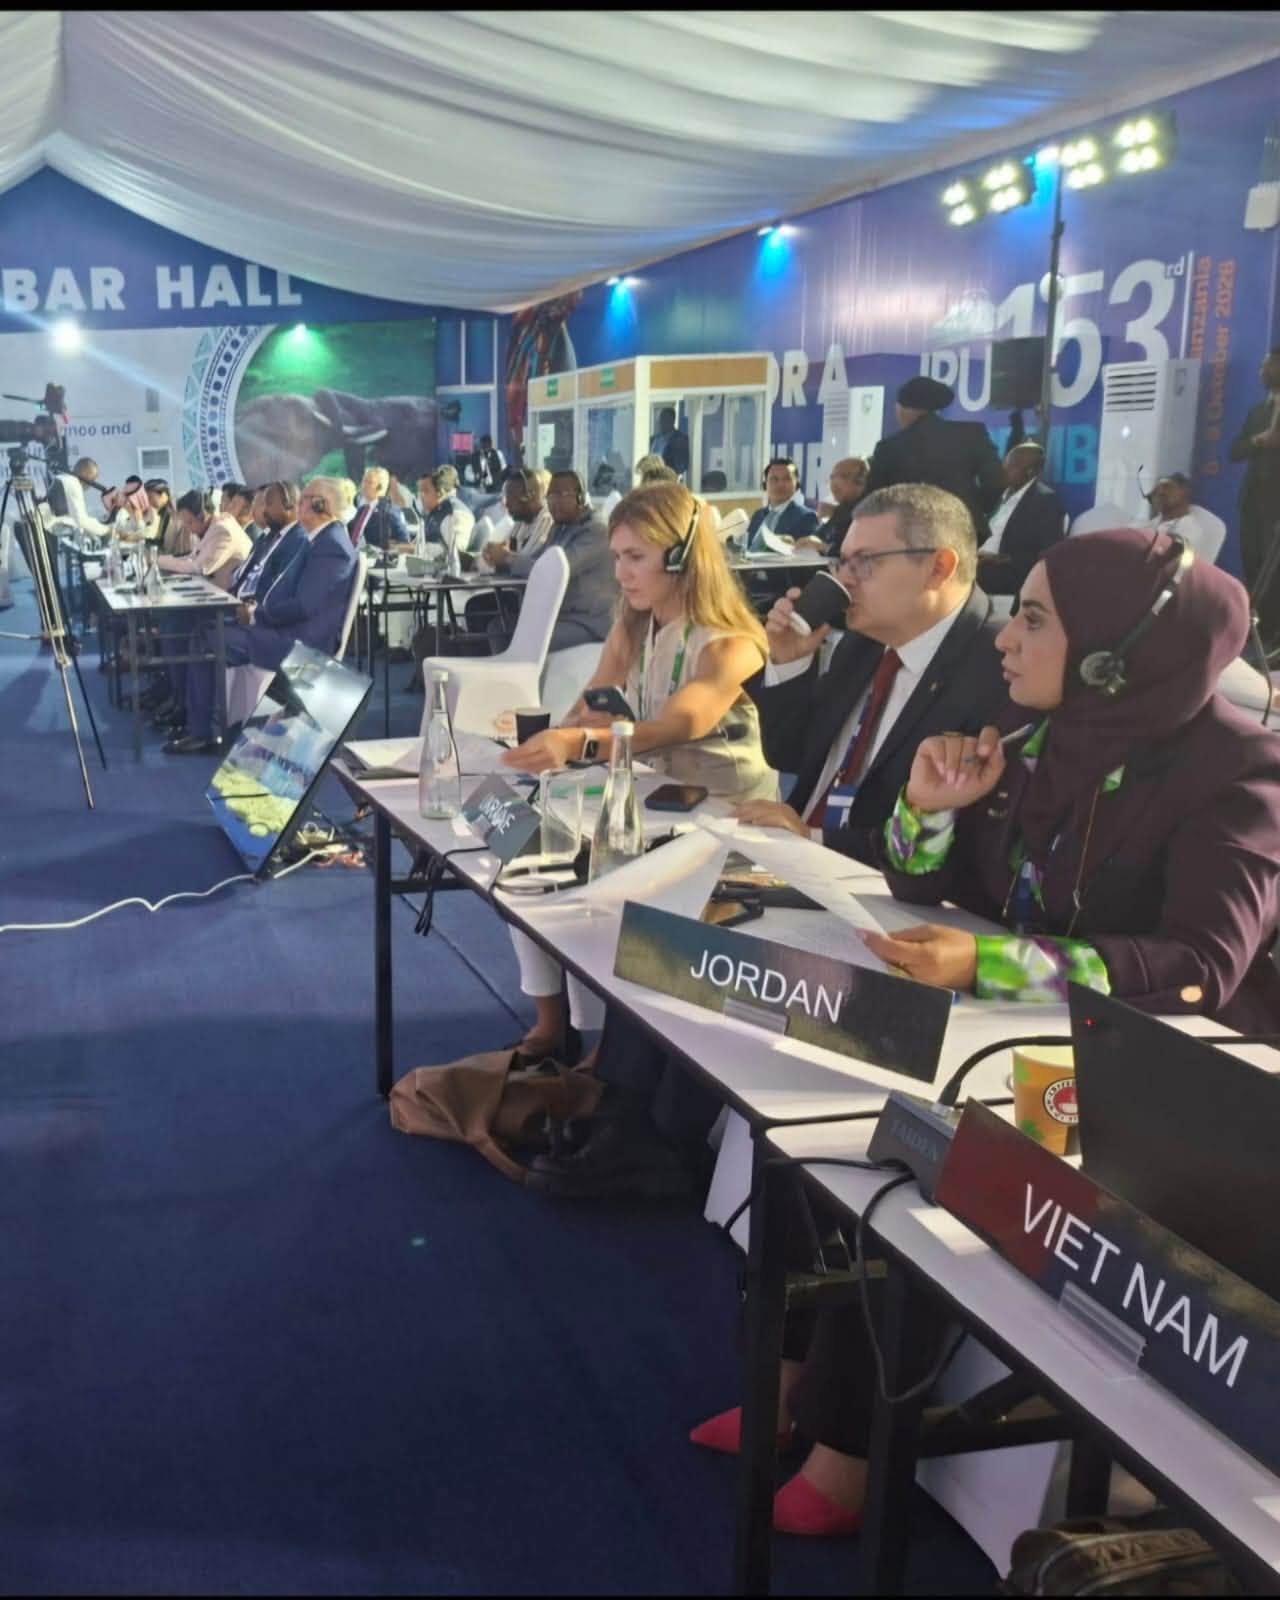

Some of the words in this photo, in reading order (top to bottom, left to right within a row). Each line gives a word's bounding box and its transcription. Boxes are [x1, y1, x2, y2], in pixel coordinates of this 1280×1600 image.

[2, 266, 126, 312] BAR
[156, 265, 302, 309] HALL
[102, 421, 132, 436] and
[690, 949, 842, 1024] JORDAN
[1021, 1183, 1120, 1285] VIET
[1122, 1262, 1249, 1388] NAM
